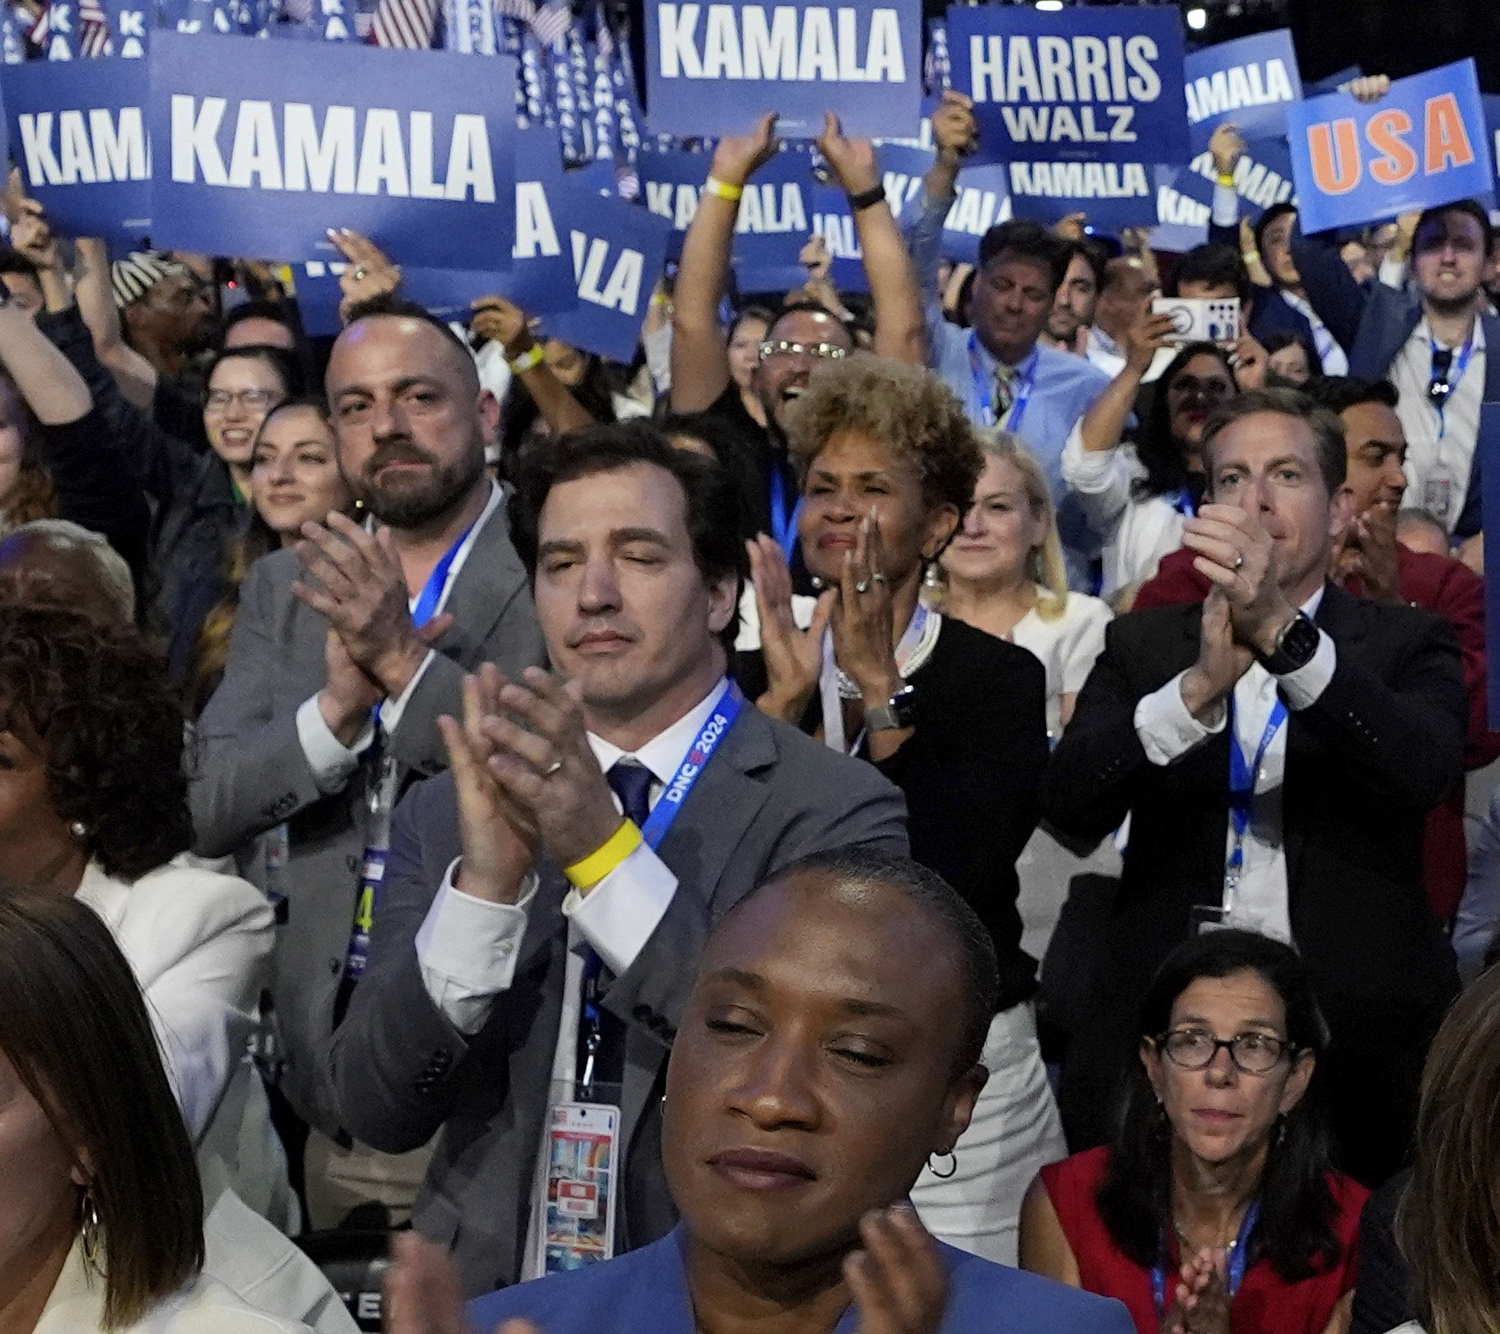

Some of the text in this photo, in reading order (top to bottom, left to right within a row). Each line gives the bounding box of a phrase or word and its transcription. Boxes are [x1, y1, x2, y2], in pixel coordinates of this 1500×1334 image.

[658, 3, 905, 83] KAMALA
[970, 34, 1160, 103] HARRIS
[1002, 104, 1137, 142] WALZ
[1185, 58, 1293, 127] MALA
[19, 107, 150, 186] KAM
[172, 95, 495, 203] KAMALA
[1011, 163, 1148, 198] KAMALA
[1307, 92, 1474, 195] USA
[647, 182, 807, 233] KAALA
[666, 714, 727, 803] DNC 2024
